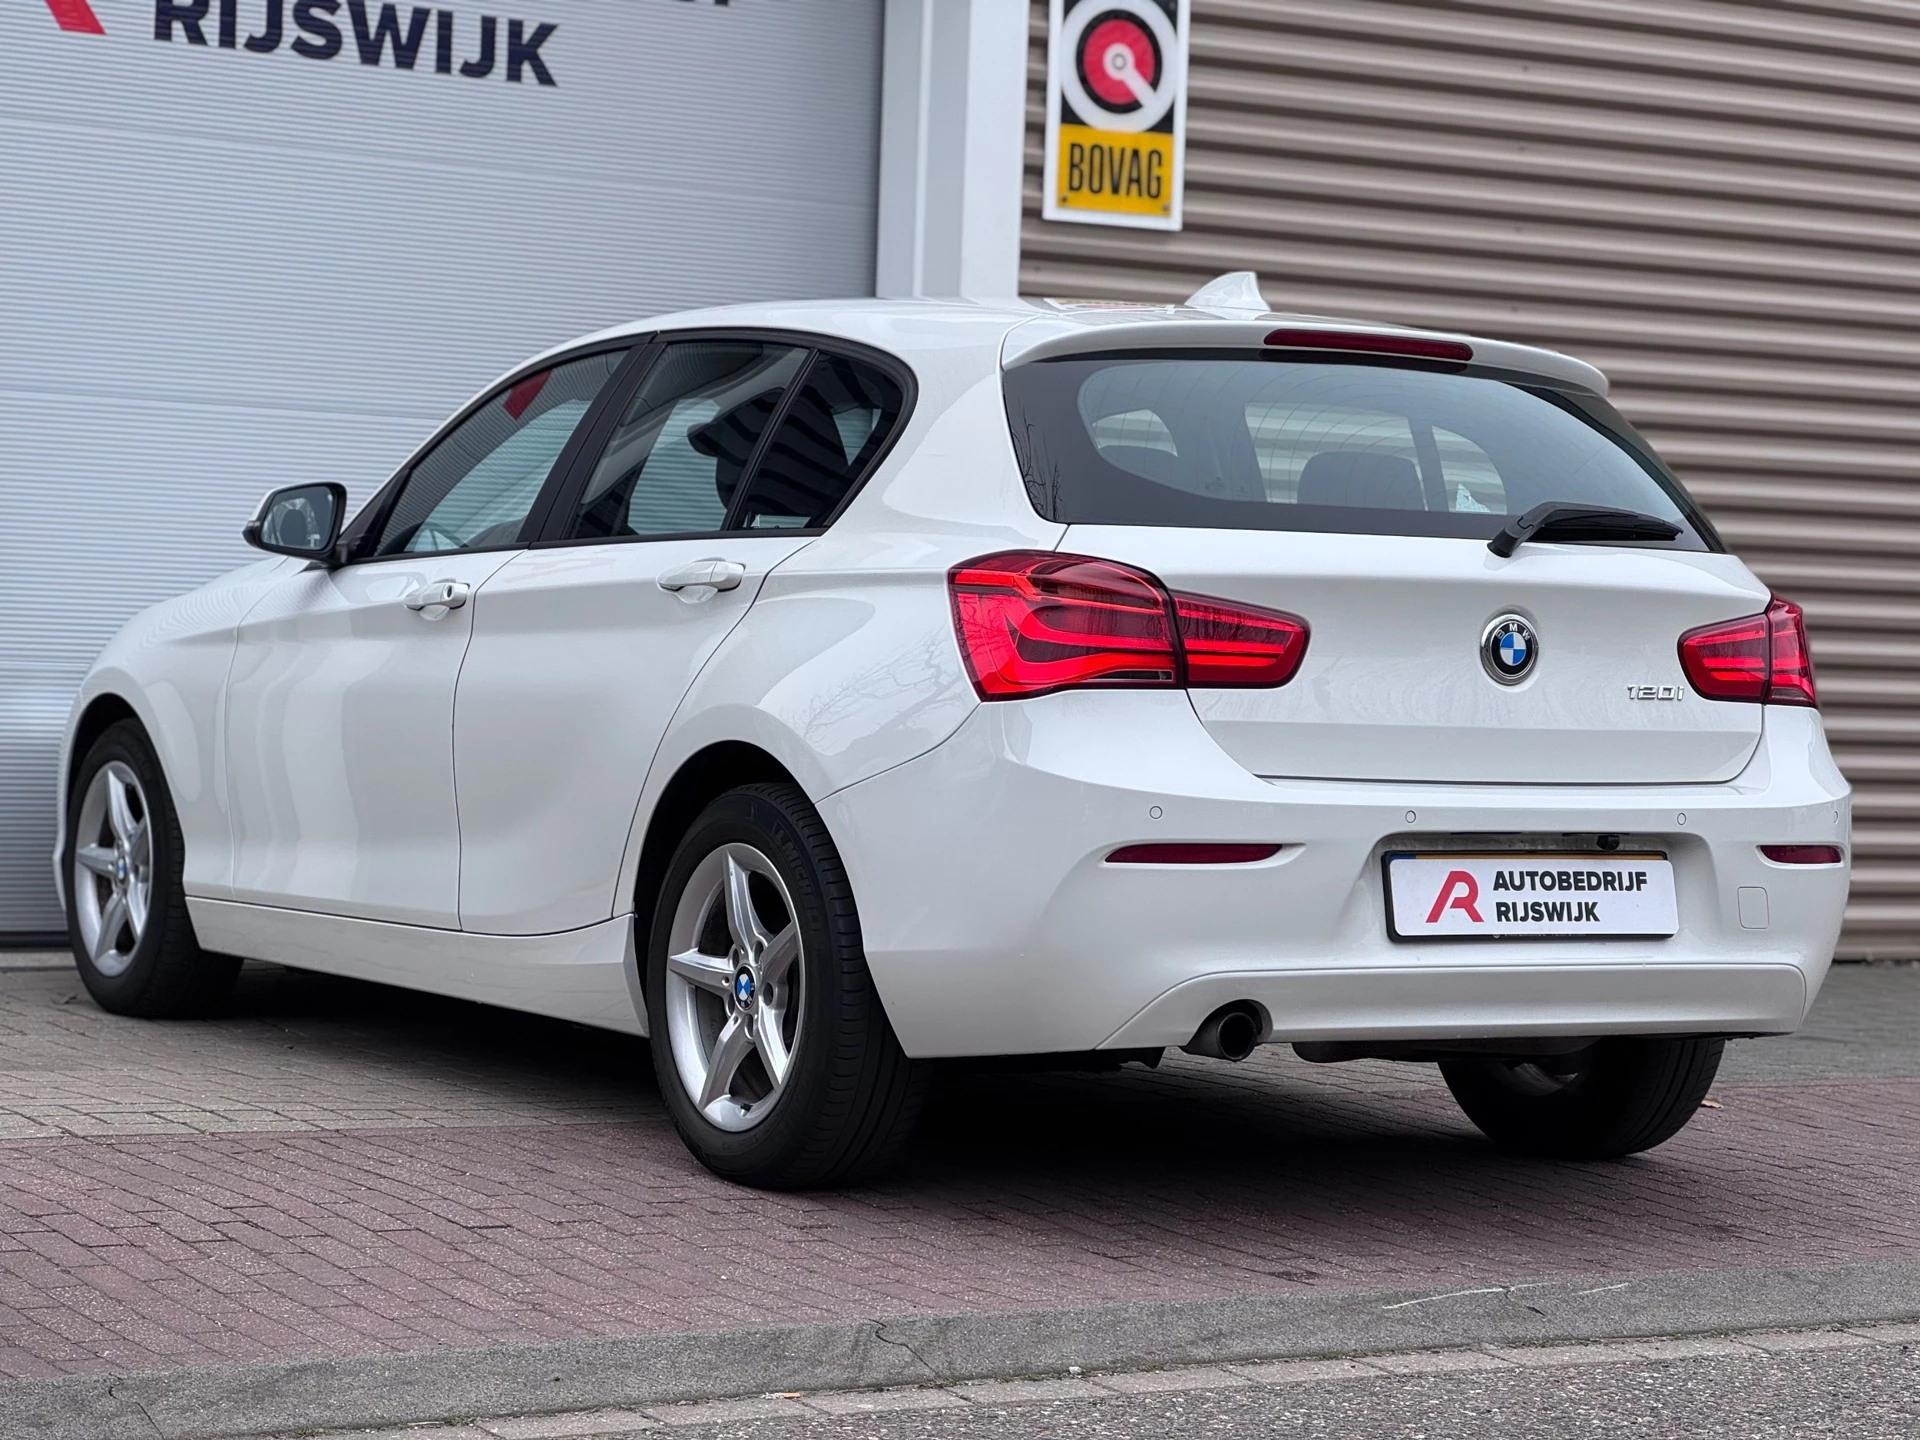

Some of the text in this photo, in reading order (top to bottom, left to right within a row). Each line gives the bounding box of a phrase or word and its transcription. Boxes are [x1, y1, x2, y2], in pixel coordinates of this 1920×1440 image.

[154, 0, 558, 87] RIJSWIJK
[1068, 143, 1162, 199] BOVAG
[1495, 623, 1531, 641] BMW
[1627, 684, 1684, 701] 120i
[1493, 870, 1647, 892] AUTOBEDRIJF
[1496, 901, 1600, 922] RIJSWIJK
